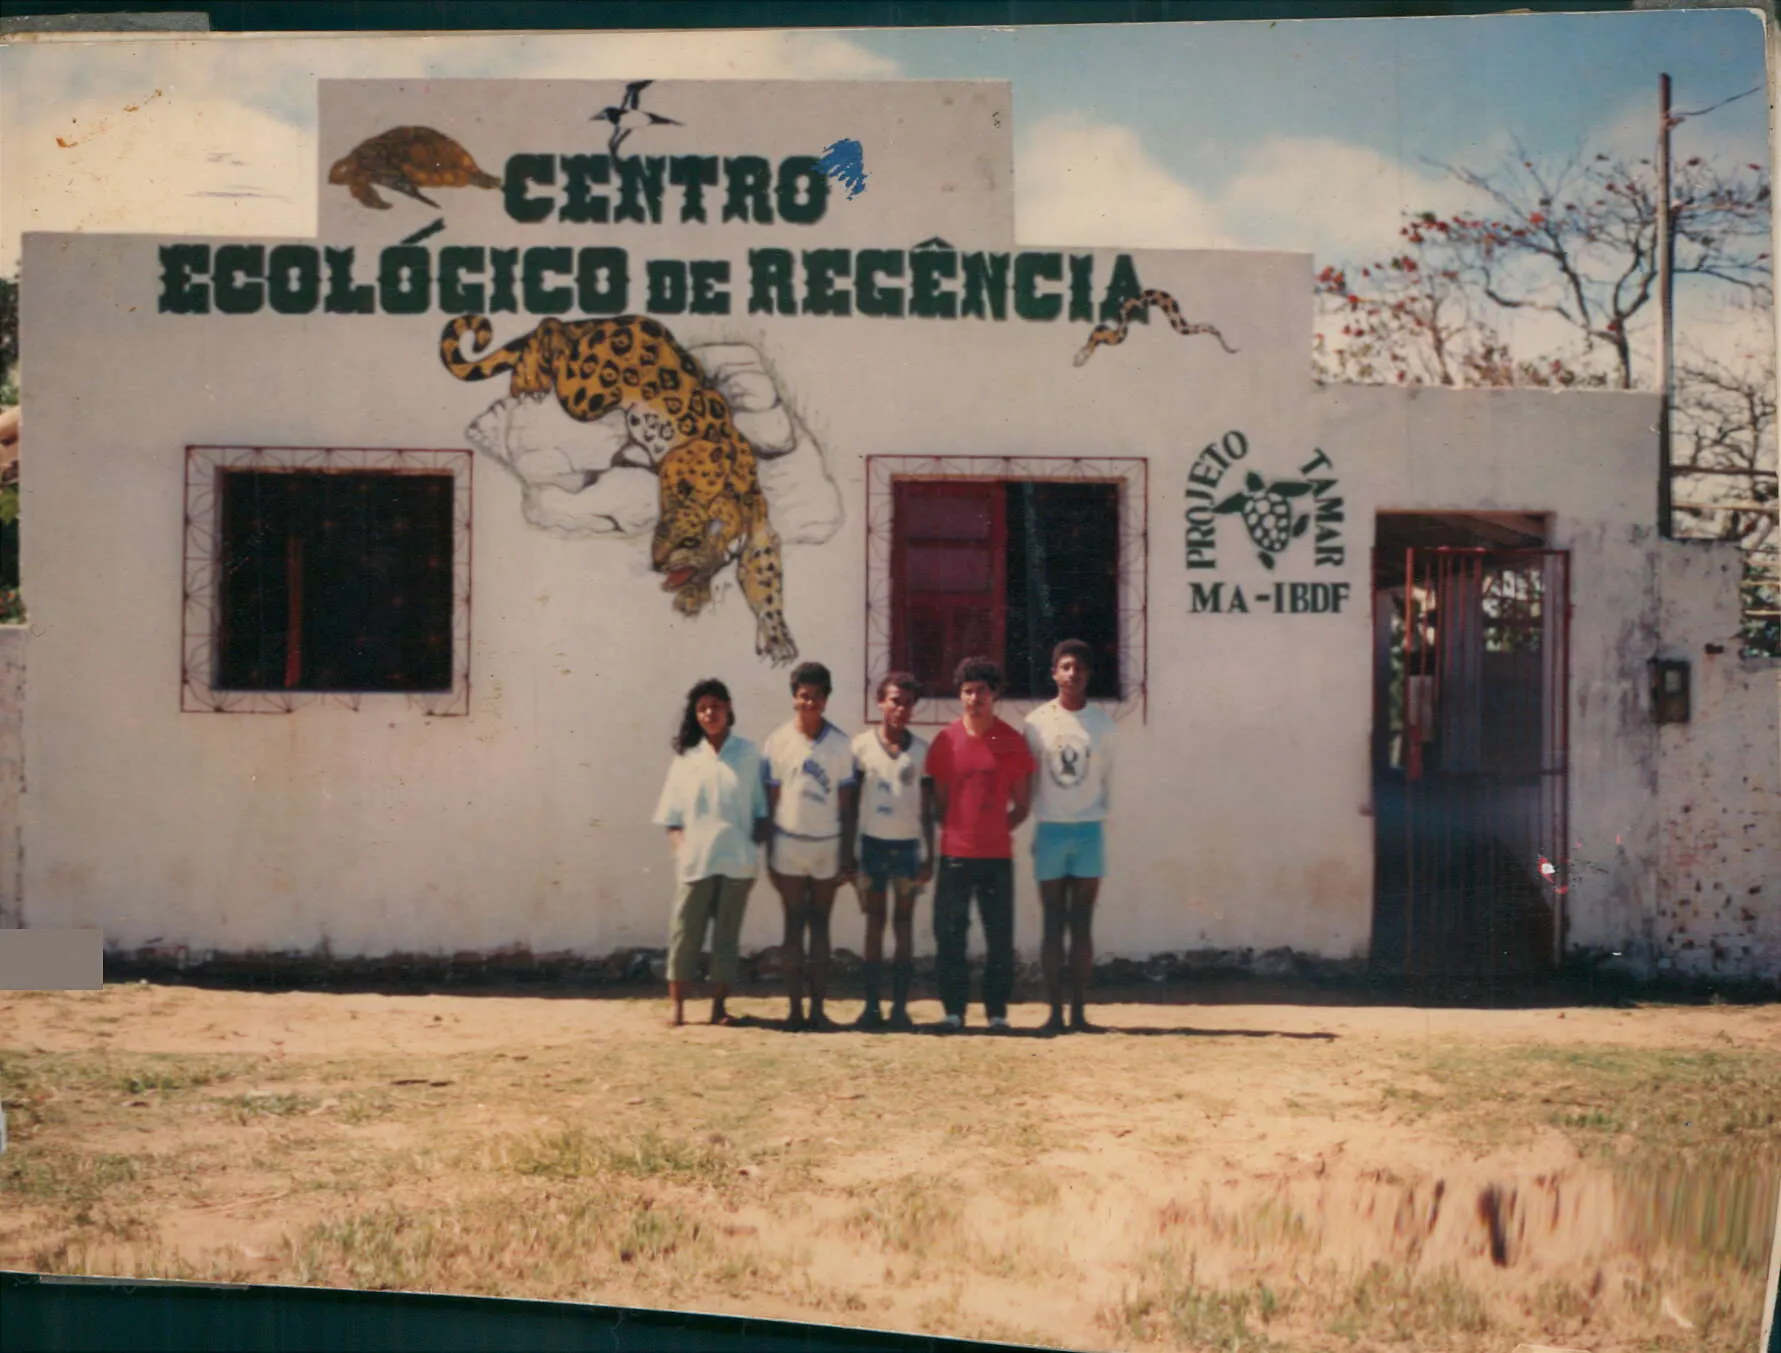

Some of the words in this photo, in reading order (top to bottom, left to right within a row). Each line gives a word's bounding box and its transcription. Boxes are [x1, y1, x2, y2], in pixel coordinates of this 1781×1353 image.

[503, 152, 829, 225] CENTRO
[158, 217, 629, 314] ECOLÓGICO
[646, 259, 732, 315] DE
[748, 236, 1150, 325] REGÊNCIA
[1185, 430, 1248, 569] PROJETO
[1299, 447, 1345, 567] TAMAR
